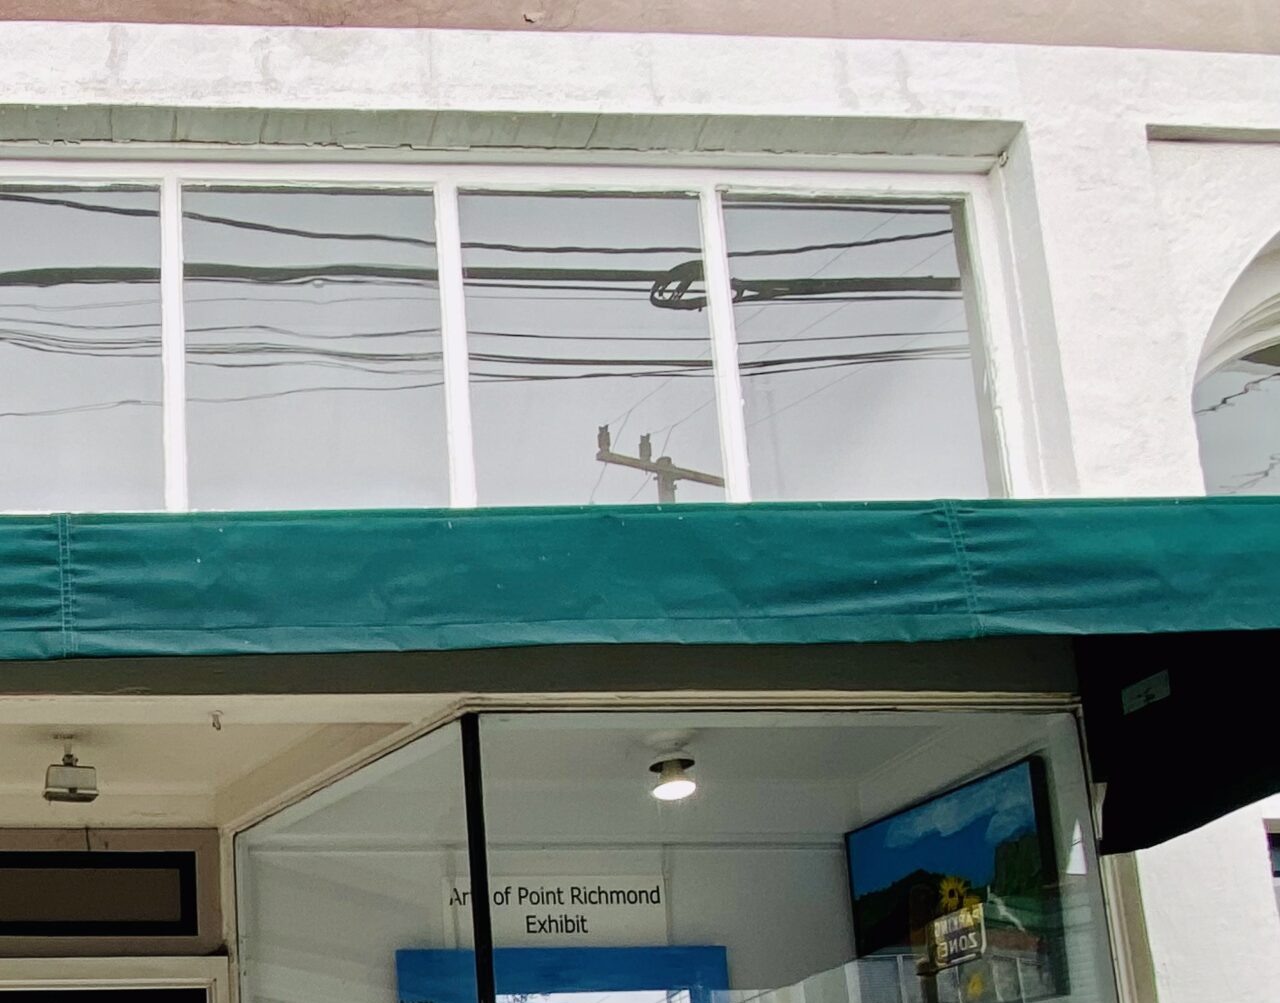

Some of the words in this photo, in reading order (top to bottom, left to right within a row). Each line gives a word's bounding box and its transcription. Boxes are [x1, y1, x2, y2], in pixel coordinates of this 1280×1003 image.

[449, 888, 472, 906] Ar
[493, 886, 512, 906] of
[518, 886, 565, 905] Point
[570, 885, 661, 905] Richmond
[525, 915, 588, 934] Exhibit
